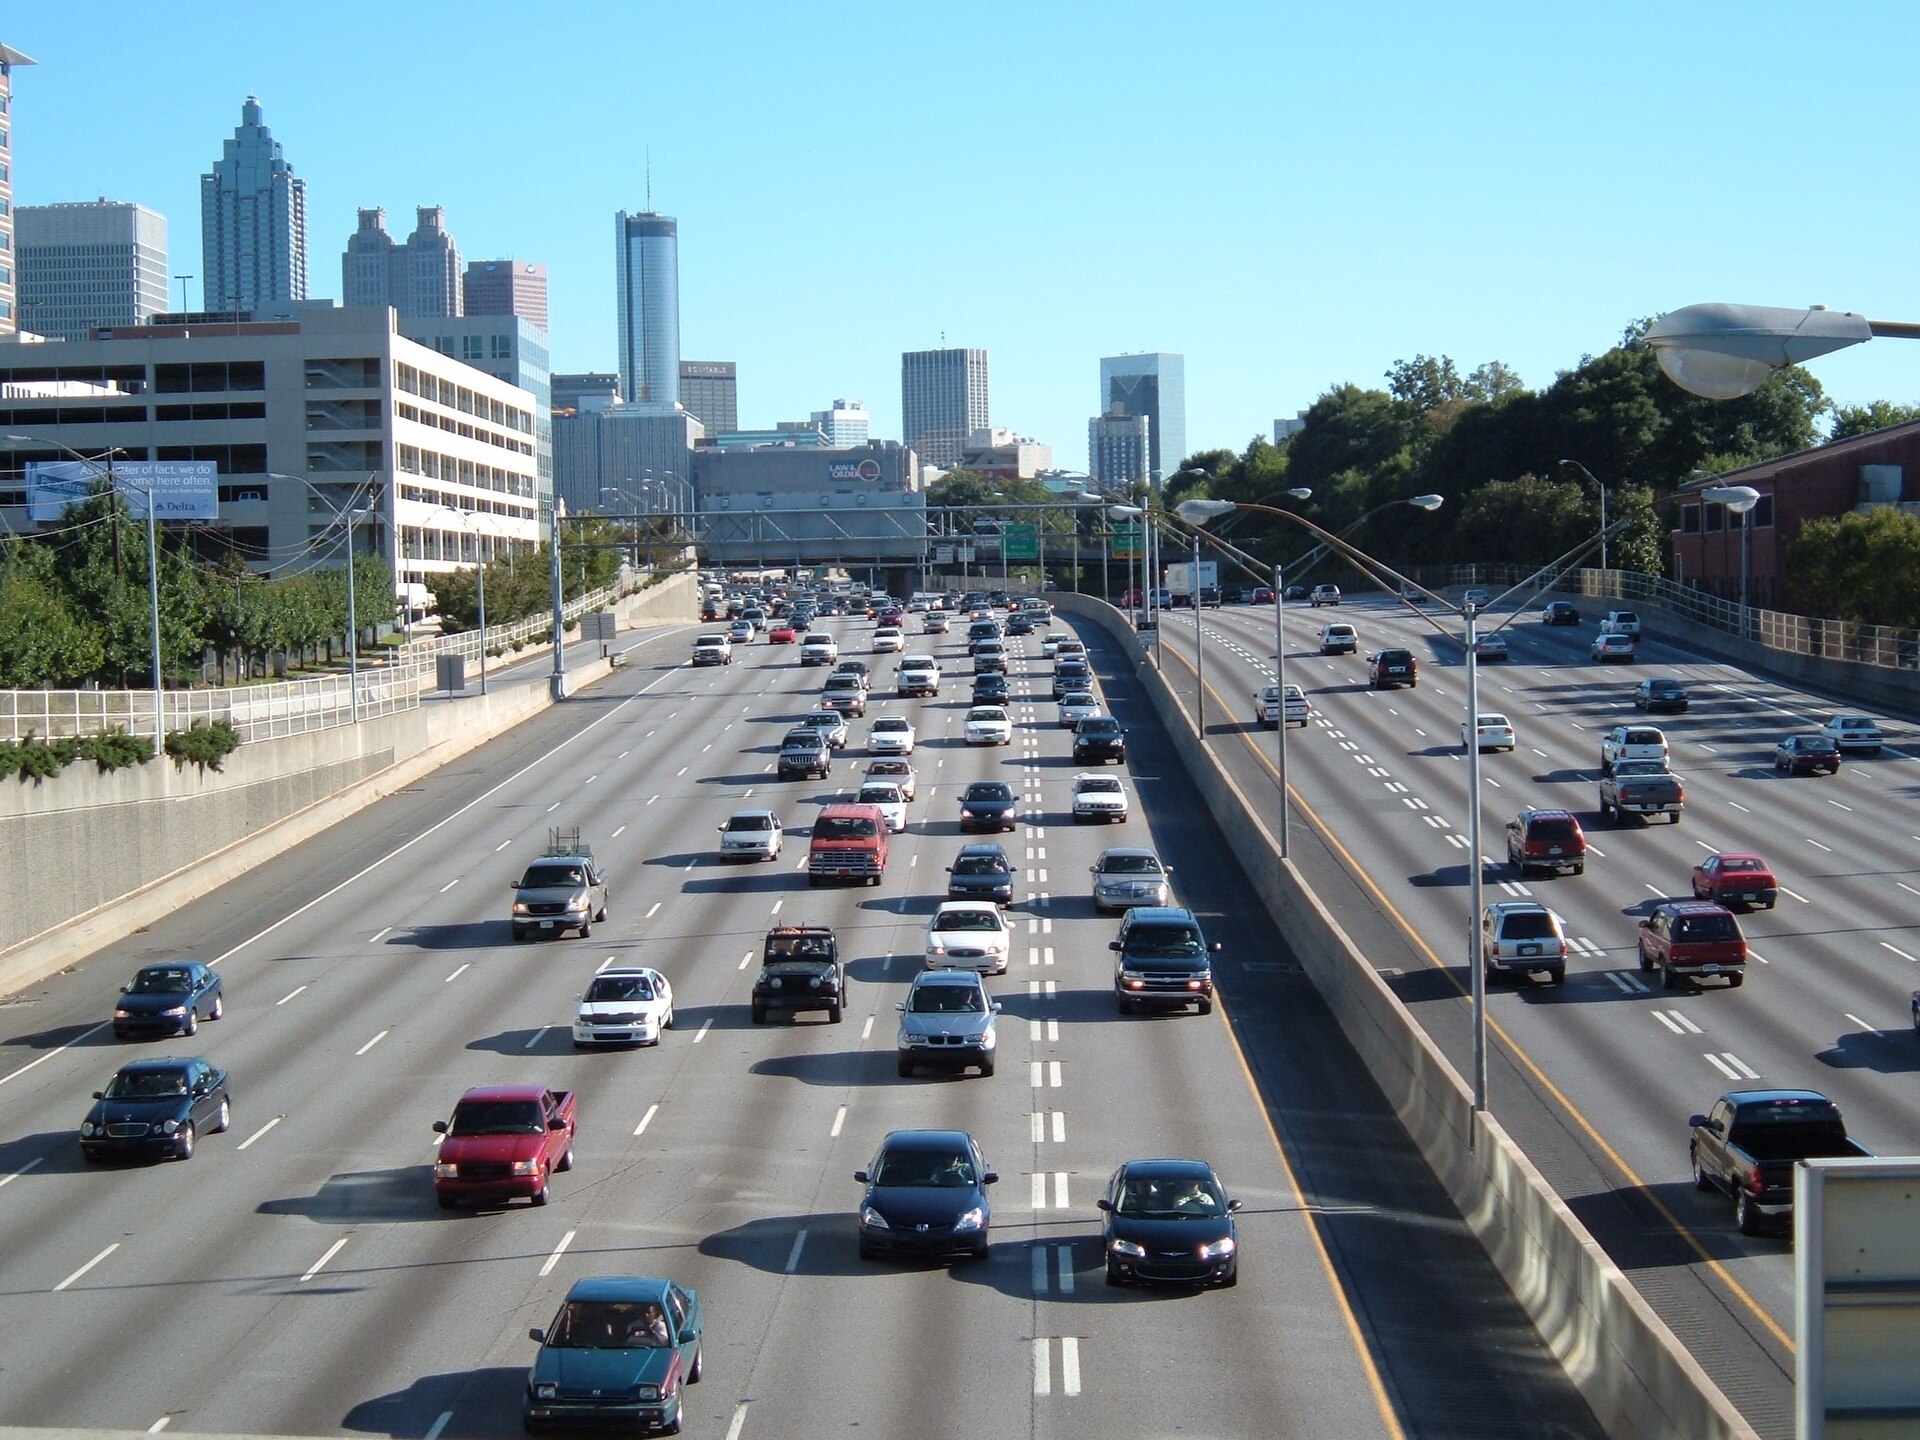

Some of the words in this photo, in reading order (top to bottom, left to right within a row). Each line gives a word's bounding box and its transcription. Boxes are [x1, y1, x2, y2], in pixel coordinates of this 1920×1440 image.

[142, 465, 152, 475] of
[179, 466, 194, 475] we
[197, 464, 211, 475] do
[829, 464, 850, 472] LAW
[157, 476, 182, 486] here
[183, 475, 212, 486] often.
[167, 501, 196, 511] Delta
